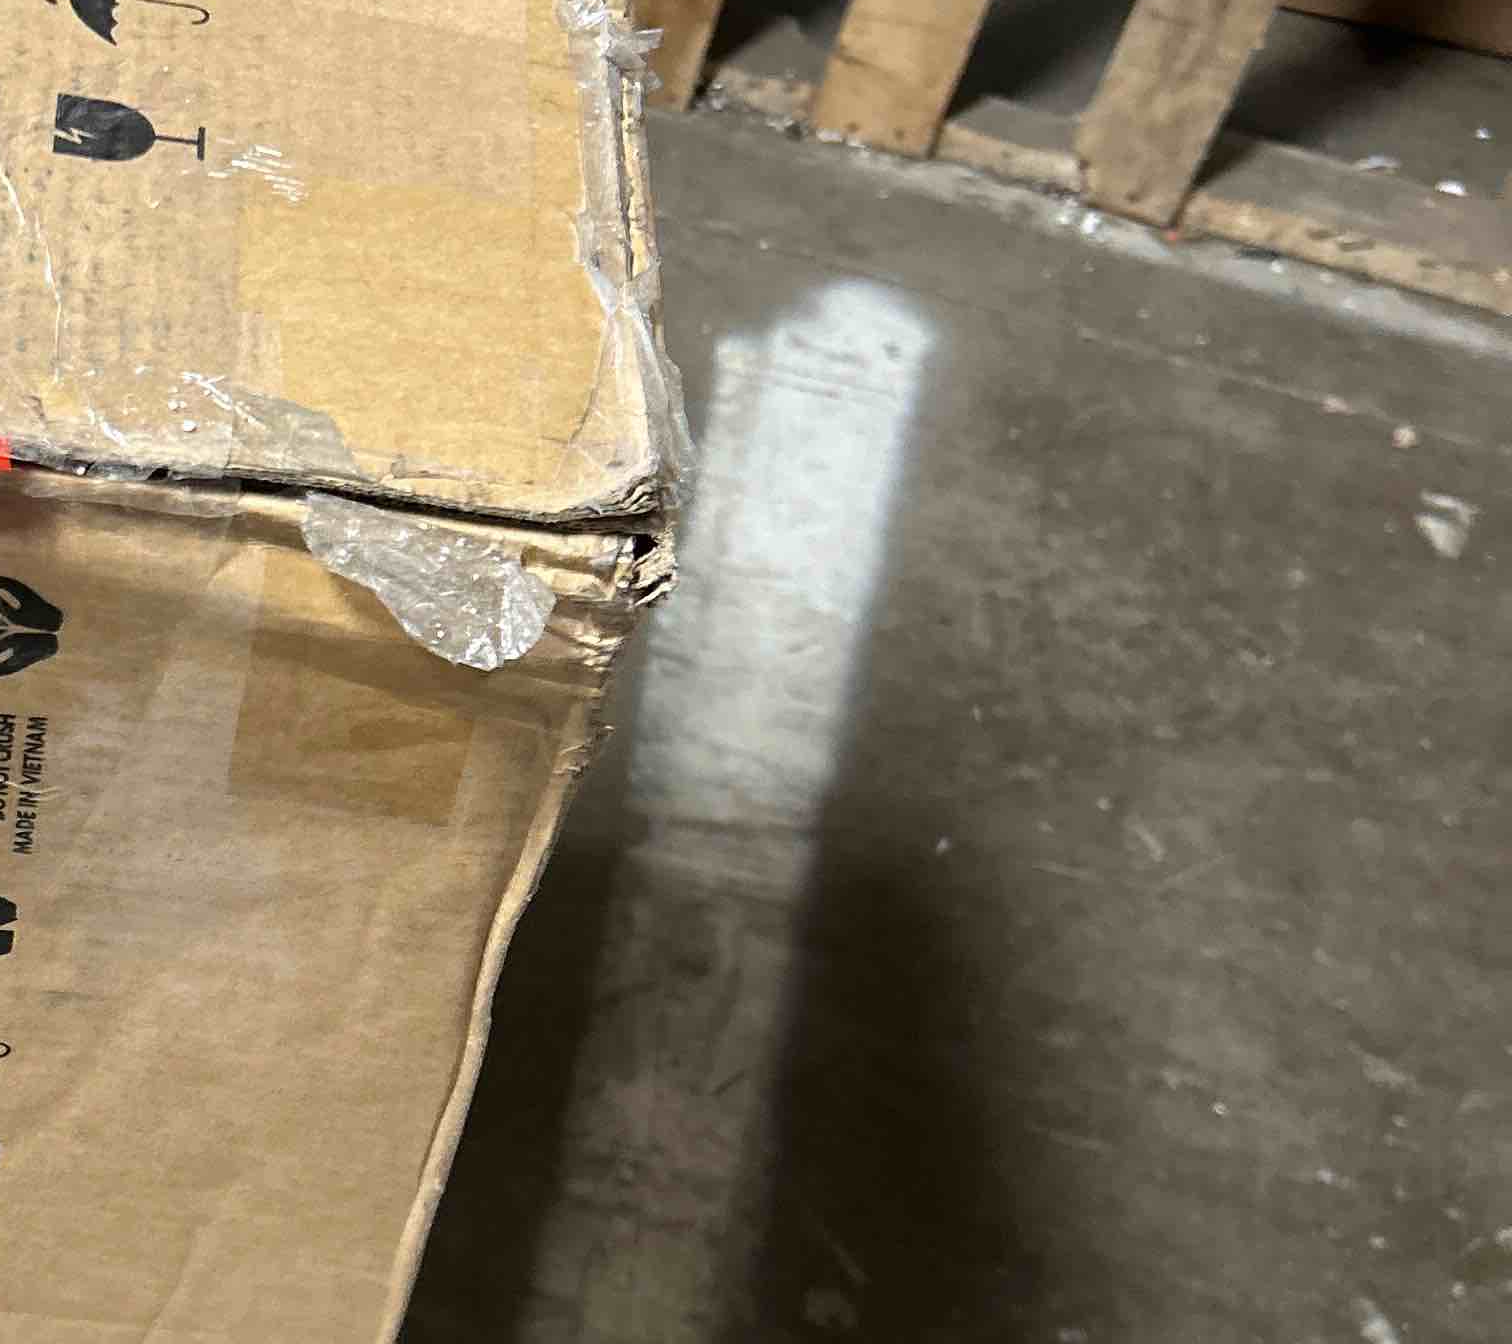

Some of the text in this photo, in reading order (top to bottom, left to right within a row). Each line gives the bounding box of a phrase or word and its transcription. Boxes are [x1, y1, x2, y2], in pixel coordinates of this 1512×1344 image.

[13, 717, 47, 854] MADE IN VIETNAM
